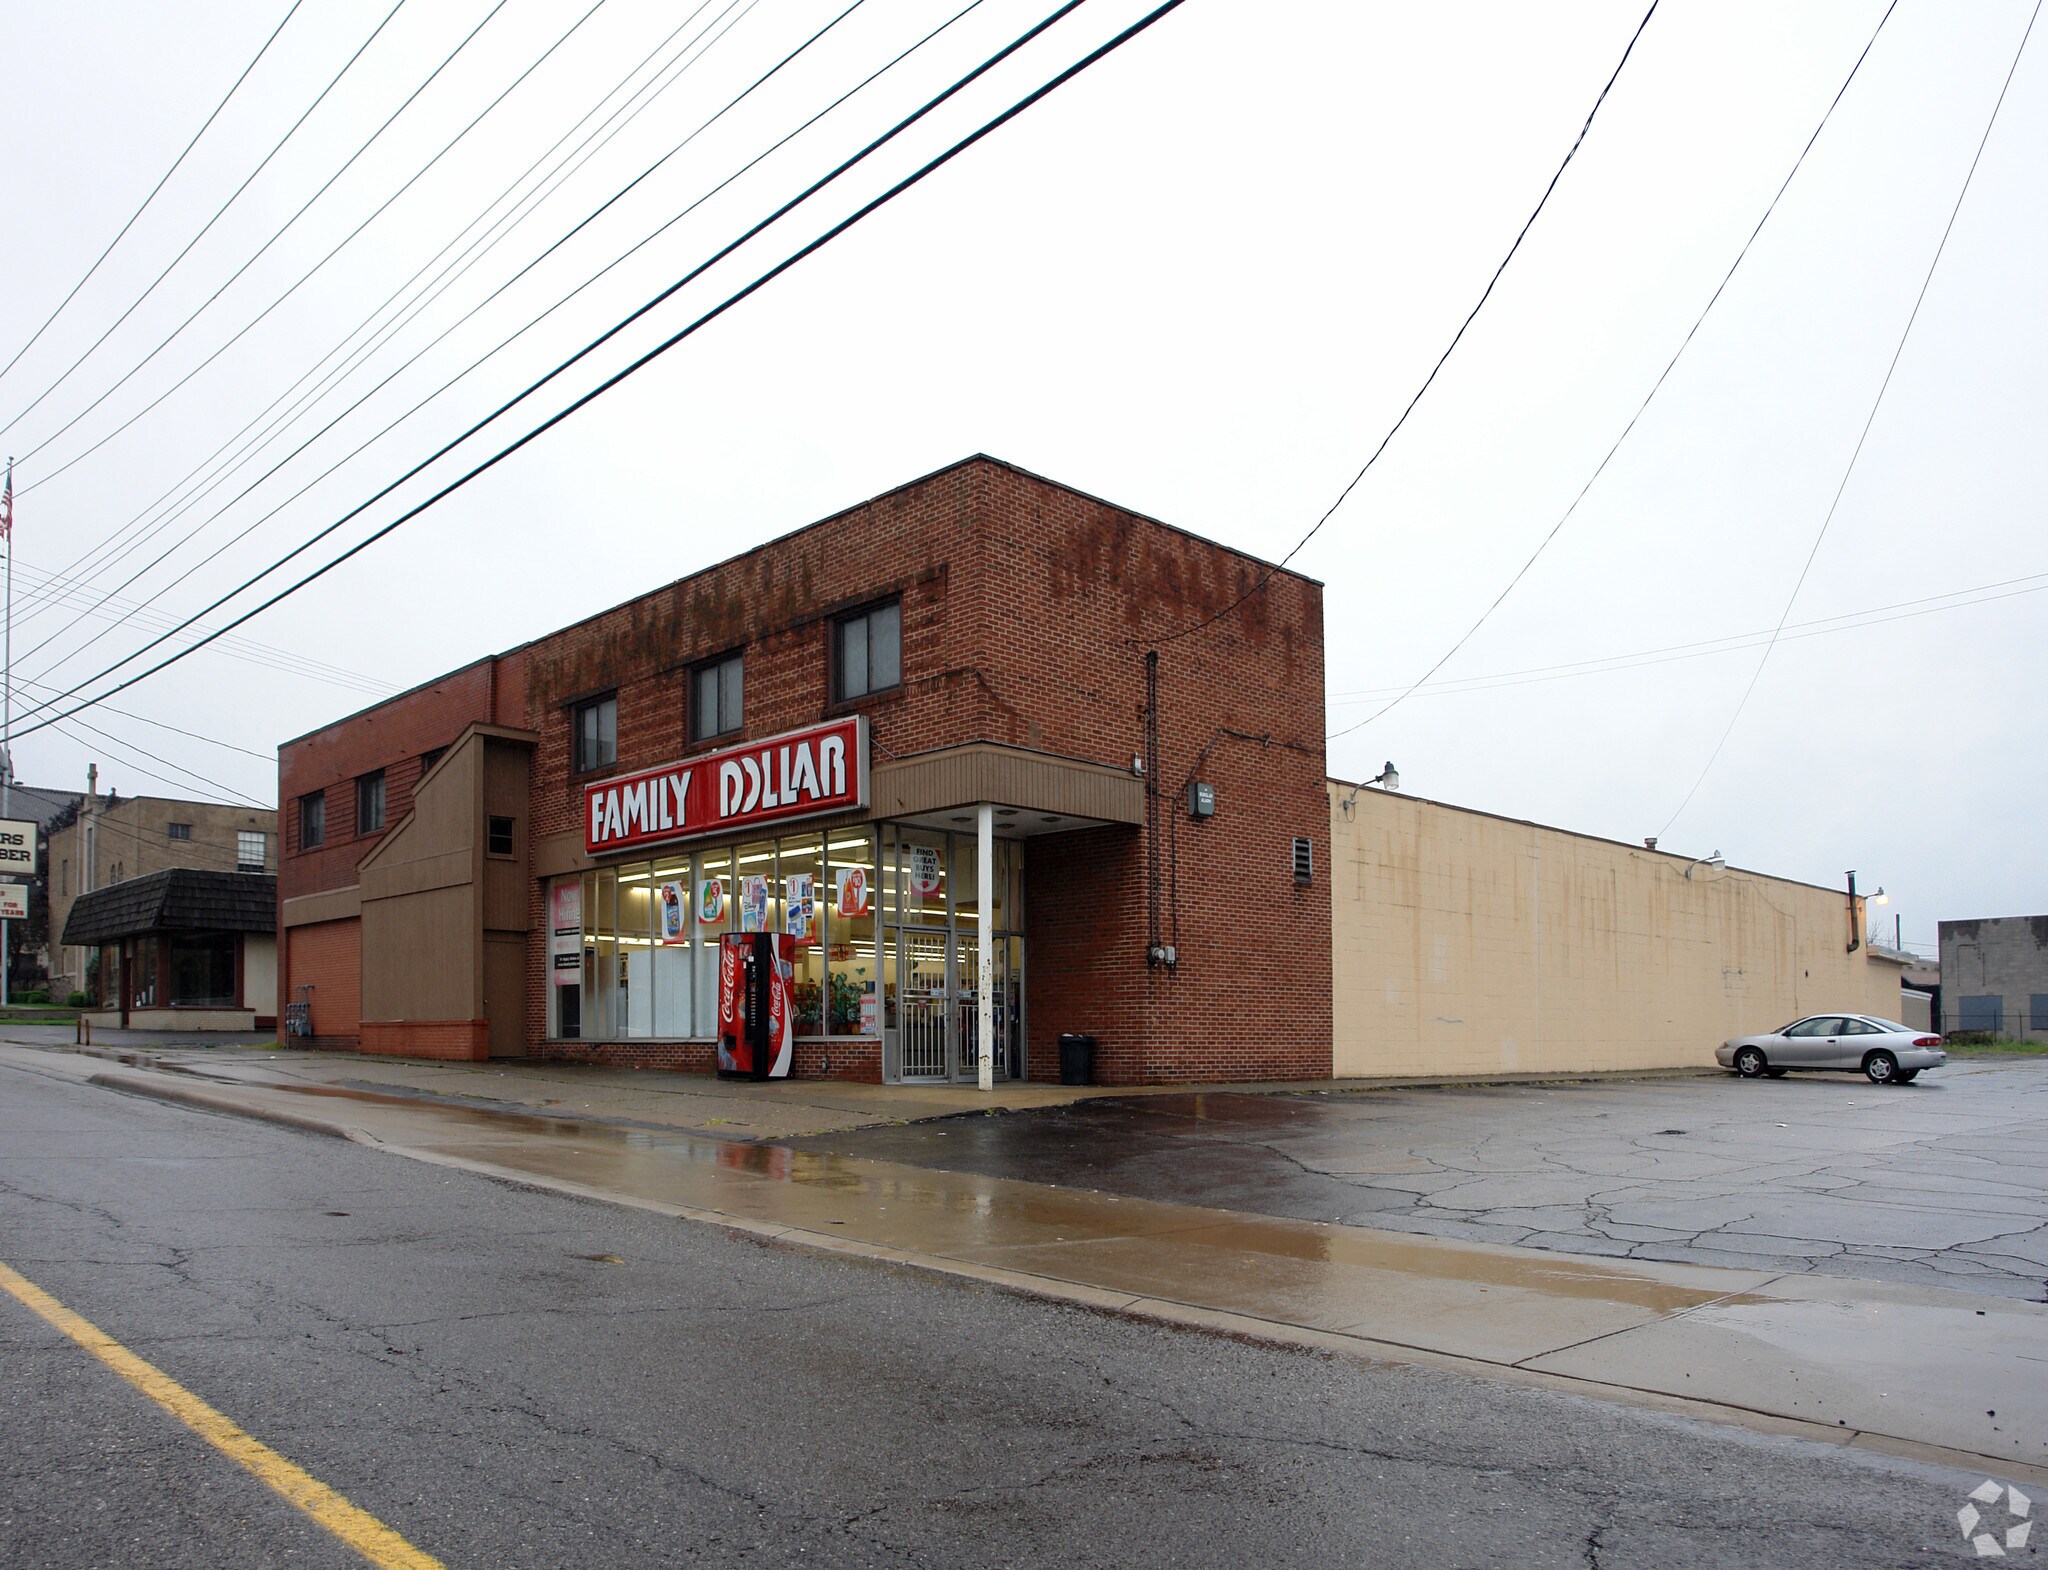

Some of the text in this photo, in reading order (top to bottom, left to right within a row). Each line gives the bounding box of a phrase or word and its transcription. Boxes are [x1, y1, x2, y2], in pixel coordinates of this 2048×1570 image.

[591, 735, 846, 843] FAMILY DOLLAR
[0, 848, 31, 861] BER
[916, 848, 934, 857] FIND
[912, 856, 936, 865] GREAT
[915, 864, 934, 873] BUYS
